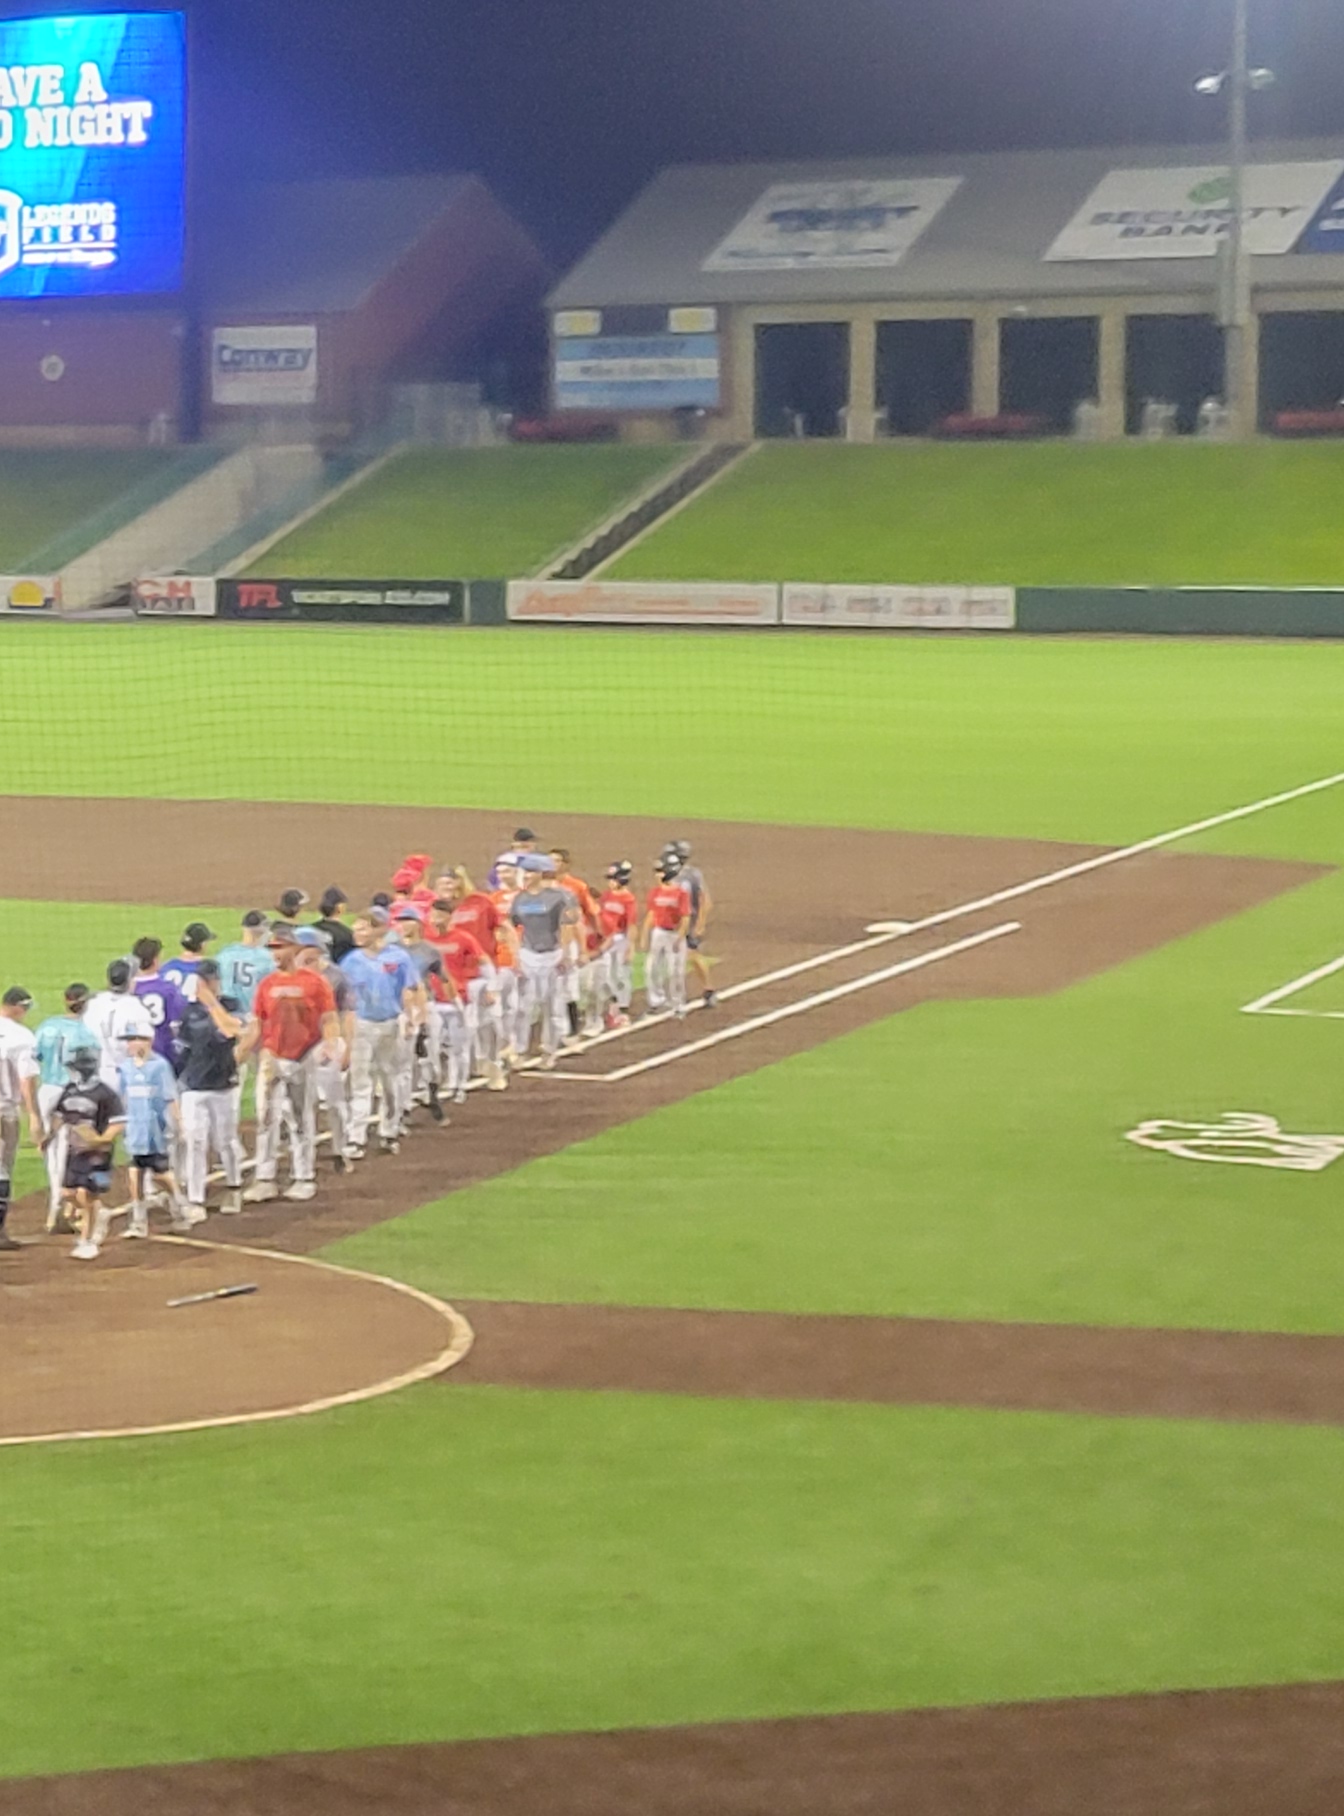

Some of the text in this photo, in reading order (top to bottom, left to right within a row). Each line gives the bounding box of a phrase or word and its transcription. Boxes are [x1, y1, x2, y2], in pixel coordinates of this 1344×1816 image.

[75, 62, 108, 103] A
[24, 101, 152, 147] NIGHT
[1091, 205, 1302, 225] SECURTY
[232, 961, 255, 988] 15
